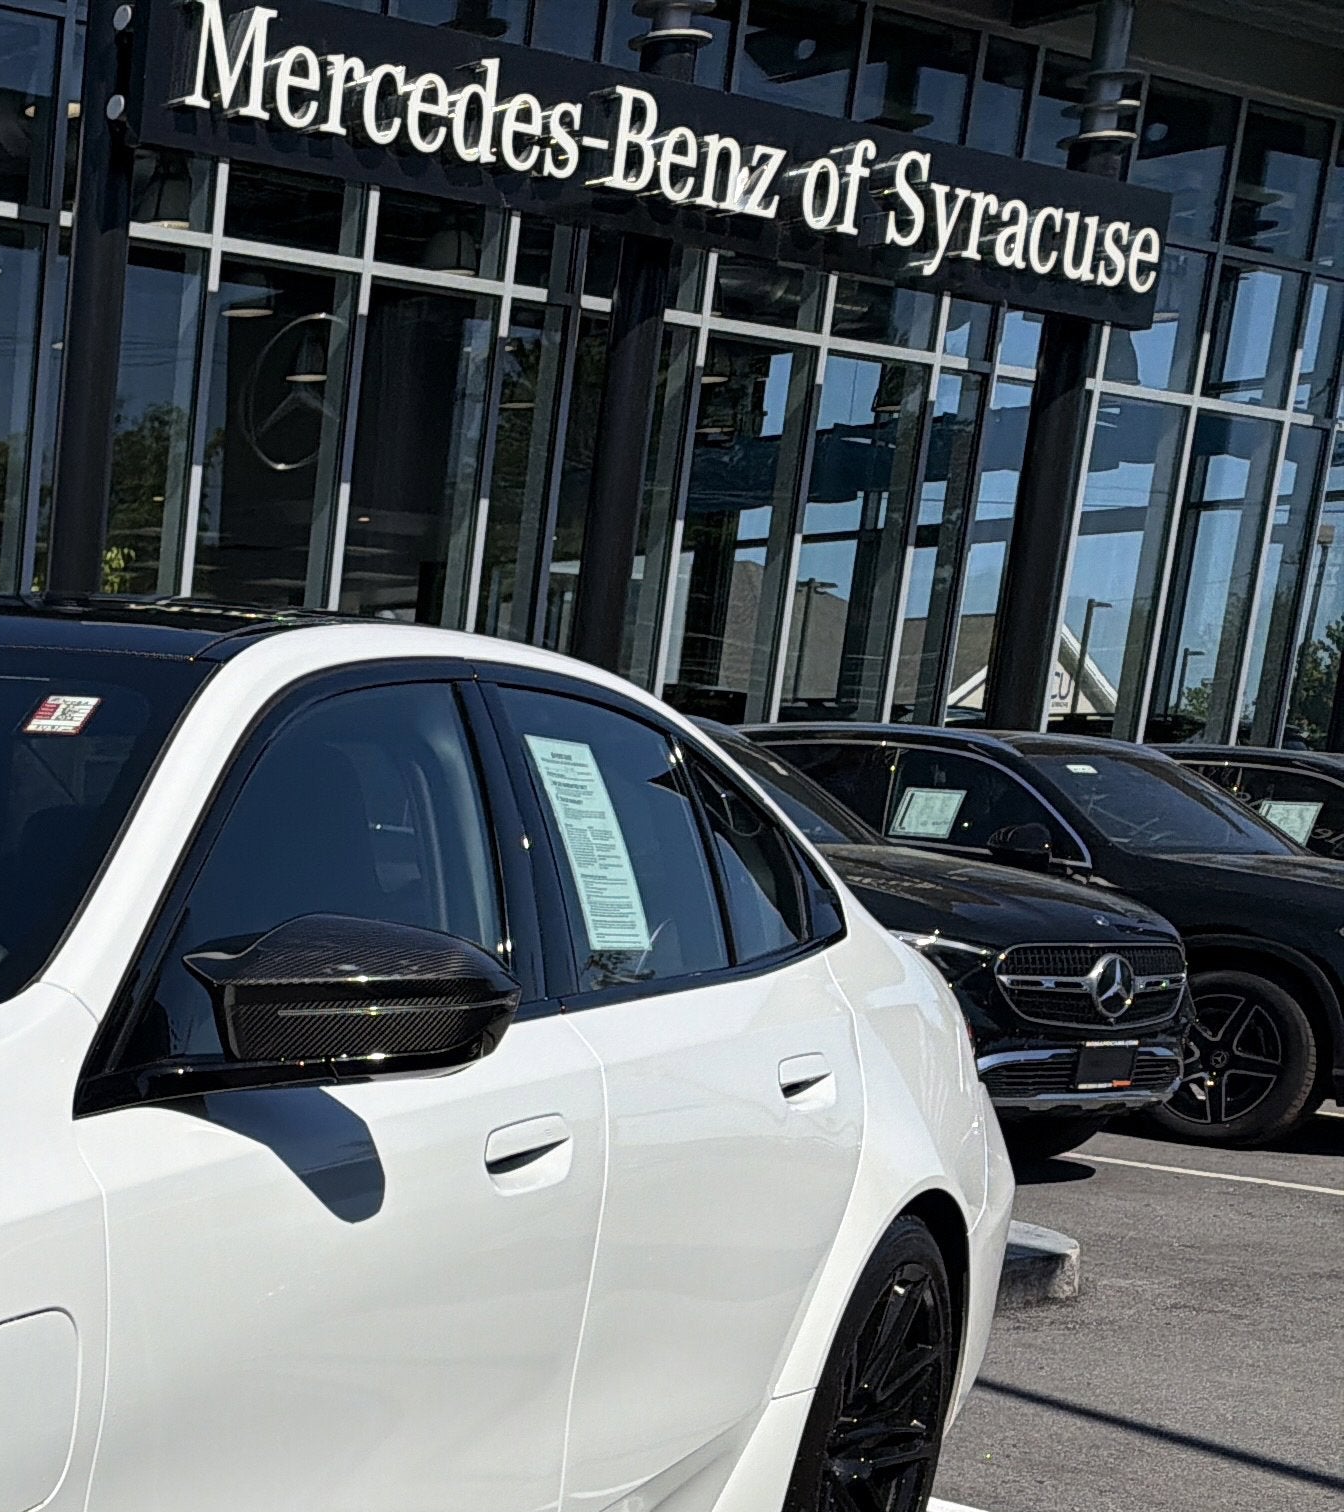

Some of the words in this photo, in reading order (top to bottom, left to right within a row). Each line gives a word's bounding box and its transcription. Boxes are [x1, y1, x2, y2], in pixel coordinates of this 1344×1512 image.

[184, 0, 786, 219] Mercedes-Benz
[802, 138, 877, 233] of
[885, 149, 1160, 293] Syracuse
